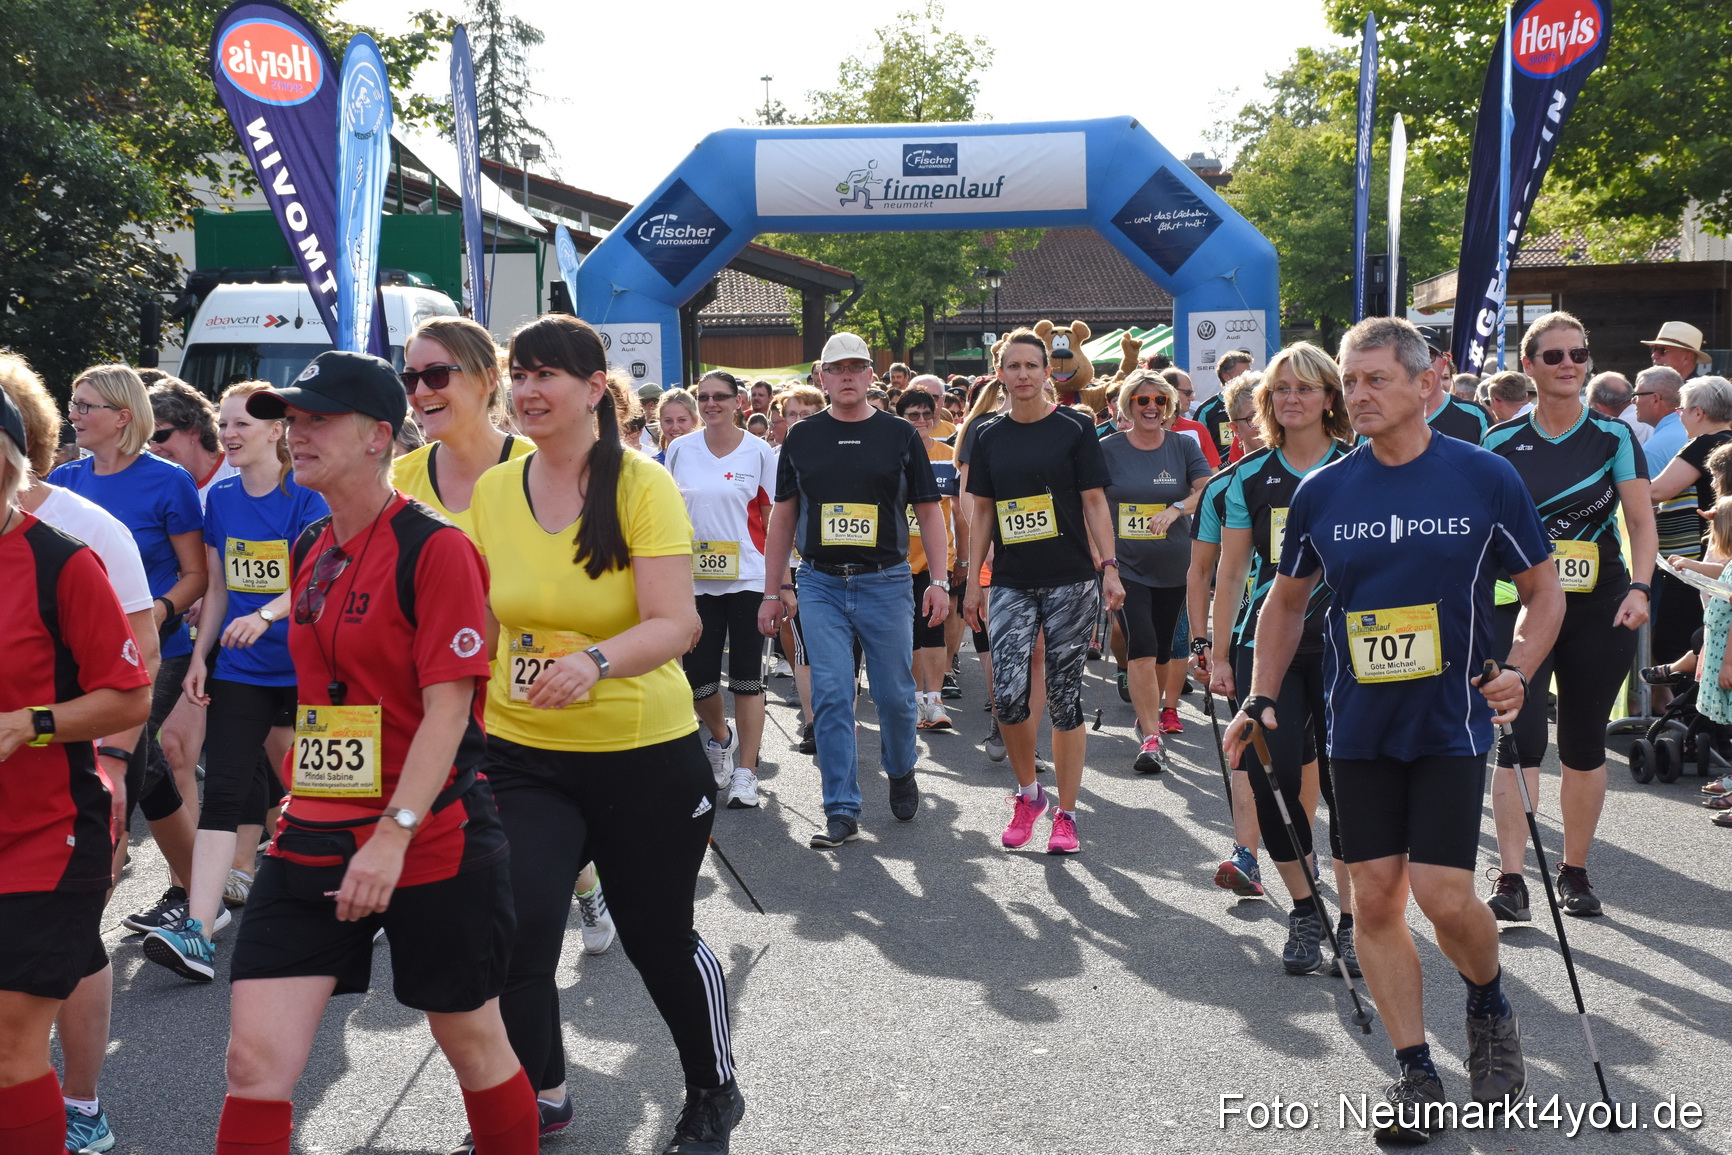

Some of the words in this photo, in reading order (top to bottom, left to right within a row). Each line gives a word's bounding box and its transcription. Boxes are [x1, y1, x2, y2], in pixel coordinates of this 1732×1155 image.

[1519, 10, 1595, 56] Hervis
[1528, 52, 1557, 66] SPORTS
[914, 155, 955, 165] Fischer
[884, 175, 1005, 200] firmenlauf
[883, 201, 934, 209] neumarkt
[1134, 213, 1152, 224] und
[1154, 211, 1171, 220] das
[1173, 209, 1209, 219] Lächeln
[651, 225, 715, 238] Fischer
[1157, 221, 1183, 234] fährt
[1185, 219, 1206, 227] mit!
[206, 315, 261, 327] abavent
[633, 365, 645, 375] FIAT
[1557, 519, 1571, 529] &
[1567, 485, 1614, 521] Donauer
[828, 518, 870, 534] 1956
[1005, 511, 1047, 531] 1955
[1408, 517, 1471, 536] POLES
[1334, 522, 1386, 541] EURO
[232, 558, 280, 578] 1136
[699, 555, 727, 568] 368
[1555, 559, 1590, 578] 180
[345, 591, 370, 615] 13
[1363, 633, 1416, 662] 707
[1387, 660, 1417, 669] Michael
[299, 738, 365, 771] 2353
[304, 772, 326, 781] Pfindel
[327, 772, 354, 781] Sabine
